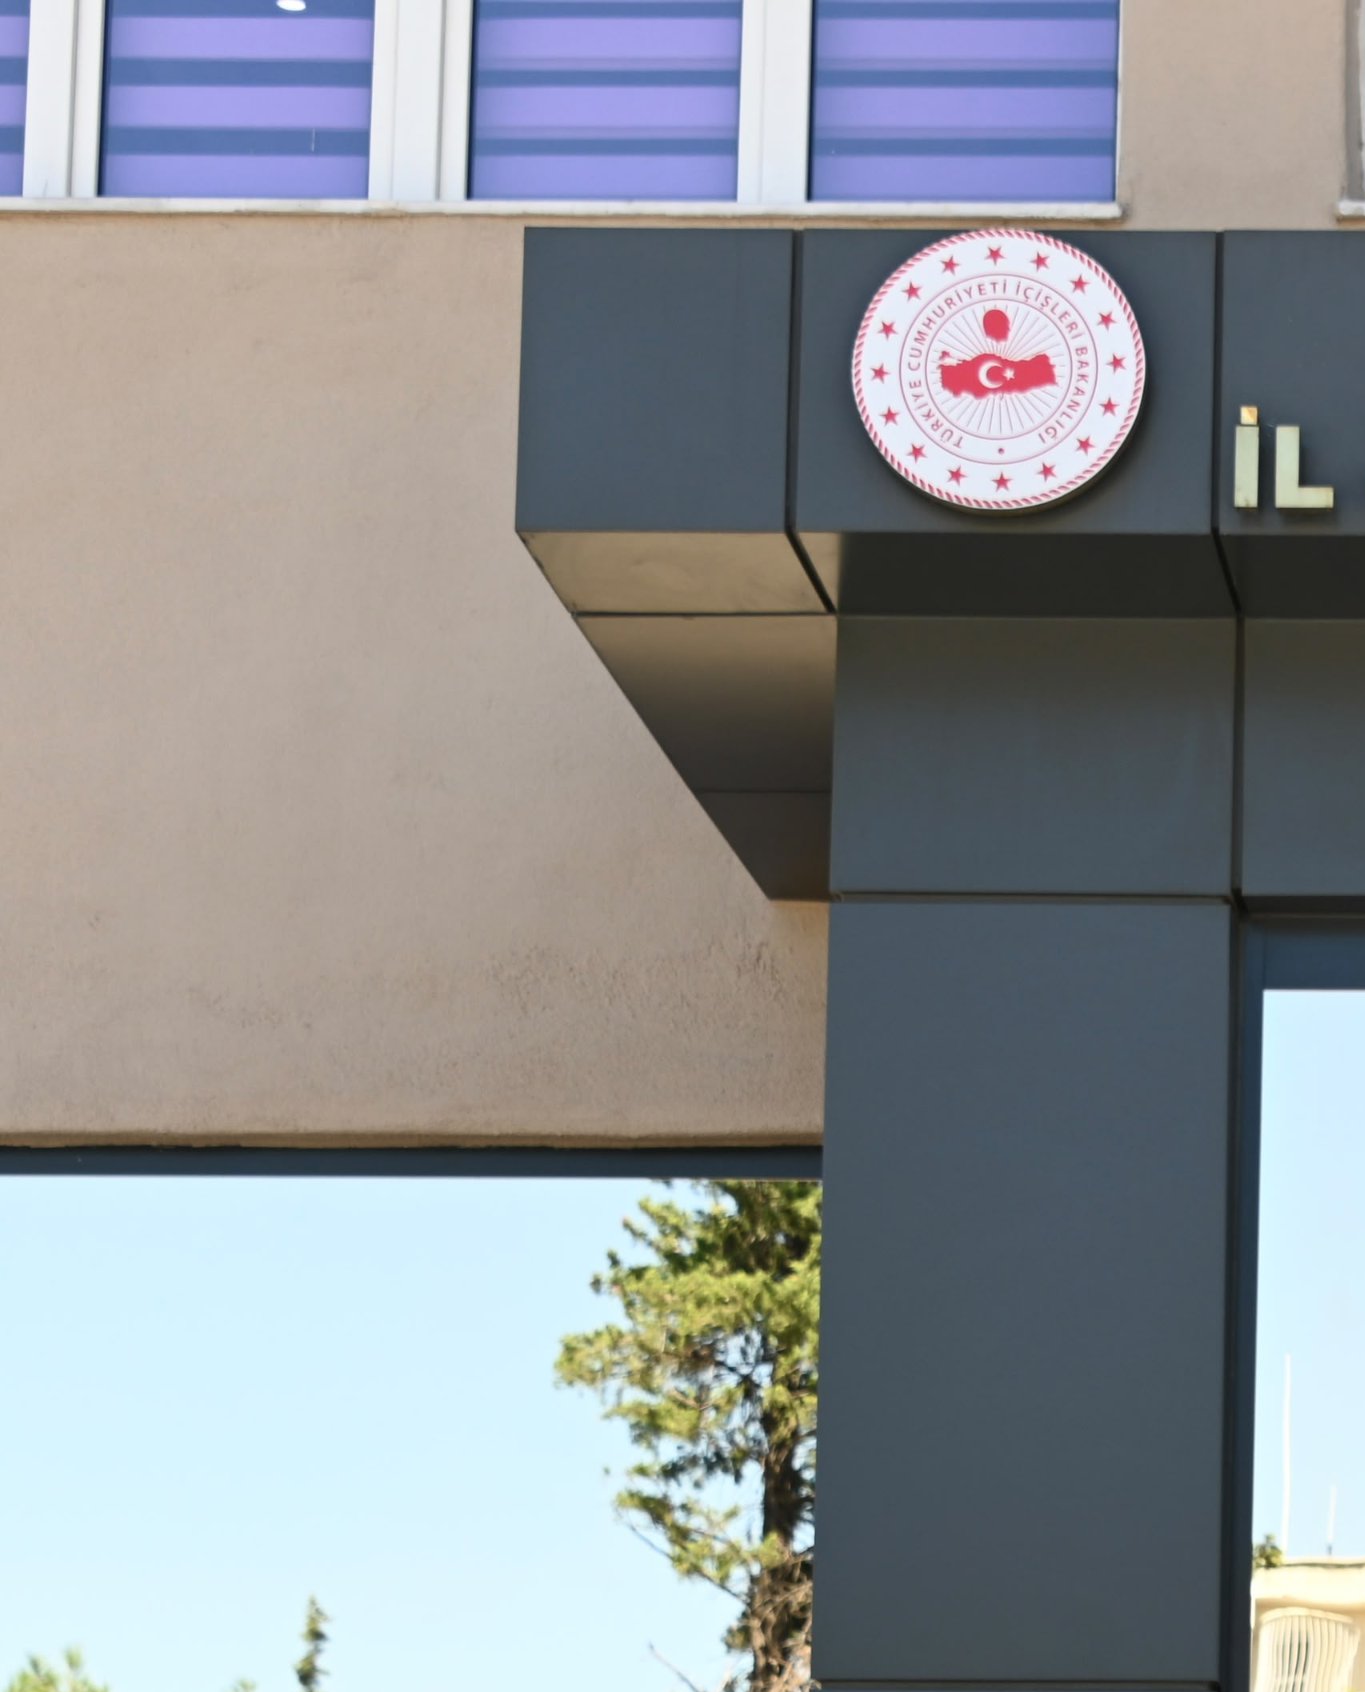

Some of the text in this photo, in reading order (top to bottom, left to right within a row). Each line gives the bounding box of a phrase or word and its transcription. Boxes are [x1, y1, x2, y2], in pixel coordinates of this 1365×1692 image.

[908, 279, 1008, 372] CUMHURİYETİ
[1015, 282, 1086, 341] İÇİŞLERİ
[1233, 405, 1335, 510] İL
